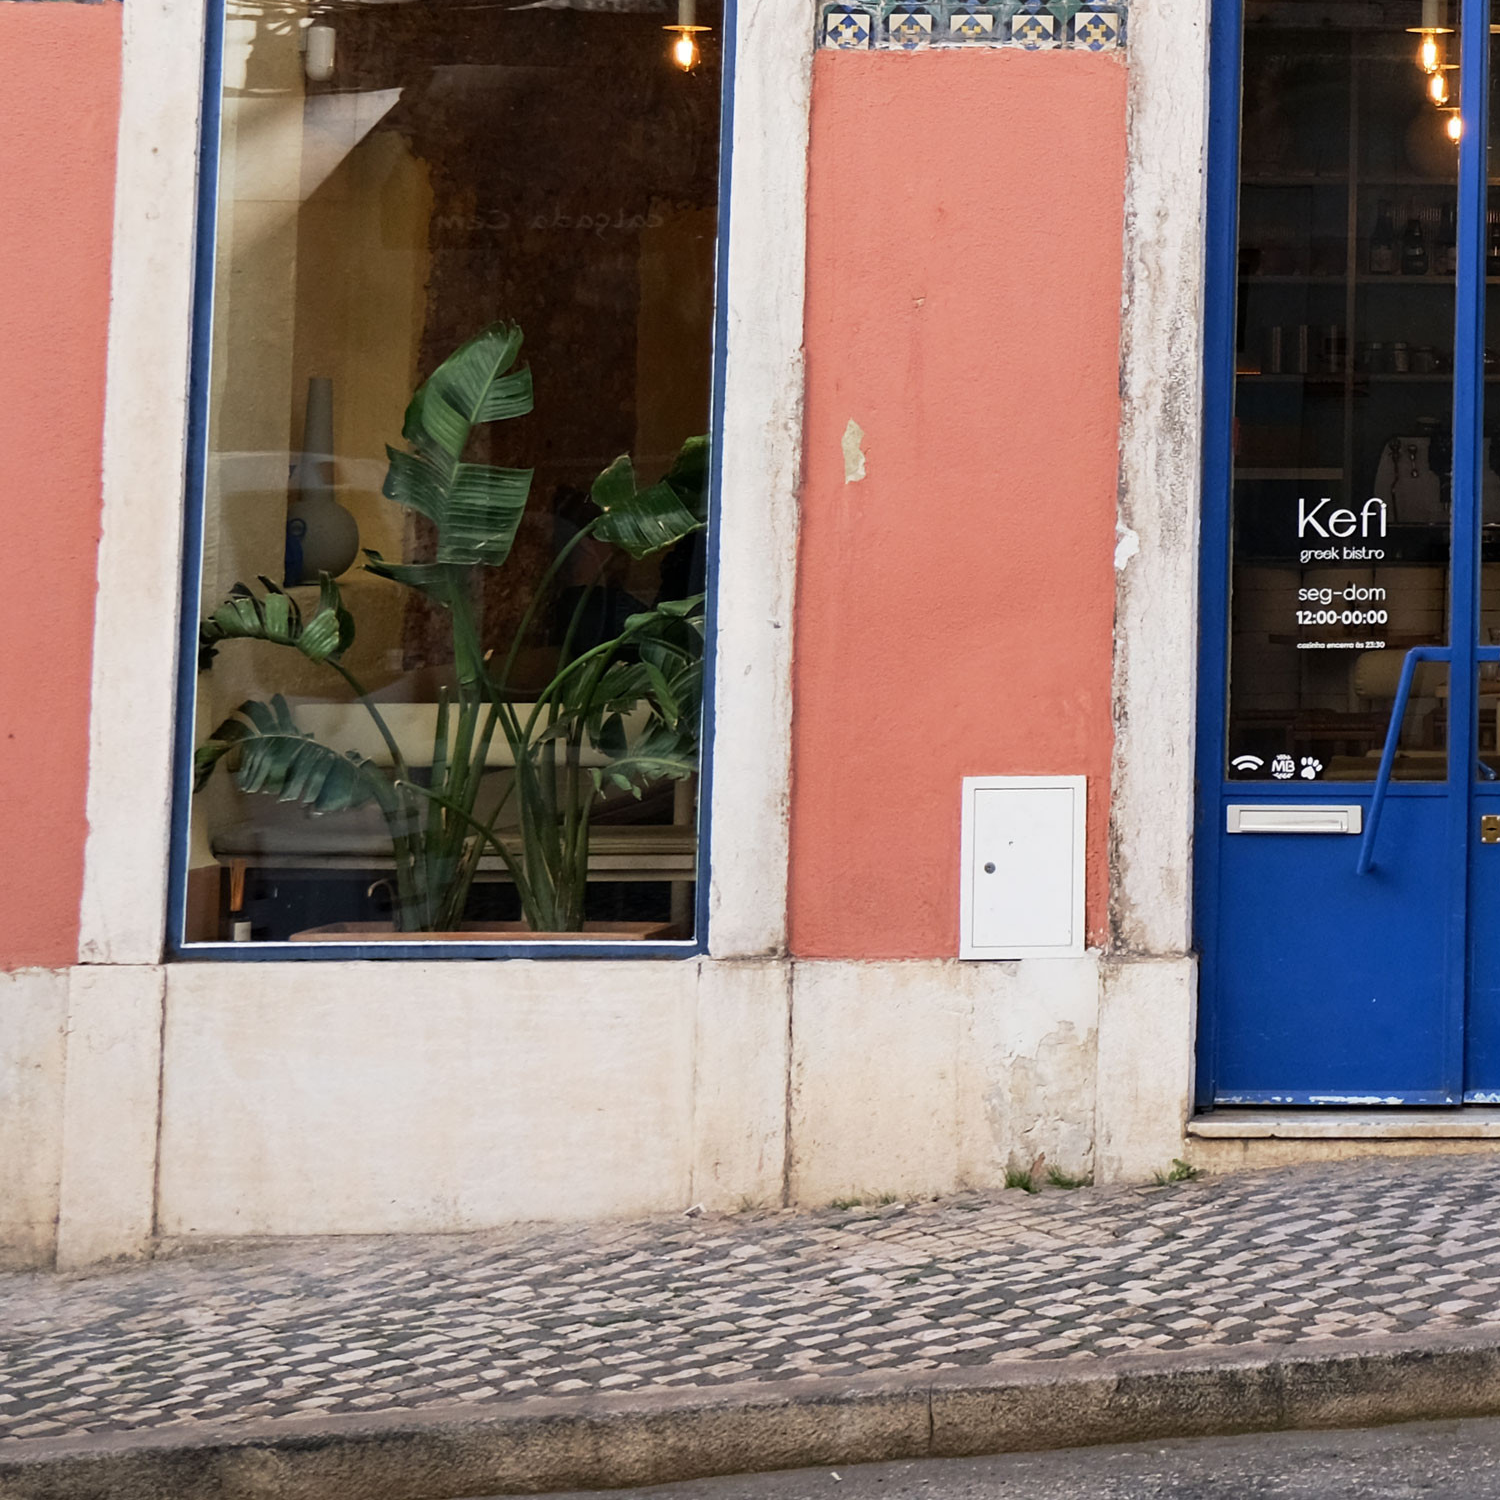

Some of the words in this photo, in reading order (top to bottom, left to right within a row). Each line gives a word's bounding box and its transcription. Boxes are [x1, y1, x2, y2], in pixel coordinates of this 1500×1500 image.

[1298, 497, 1387, 538] Kefi
[1300, 546, 1340, 564] greek
[1343, 546, 1385, 560] bistro
[1298, 583, 1386, 605] seg-dom
[1296, 610, 1388, 625] 12:00-00:00
[1271, 759, 1296, 773] MB
